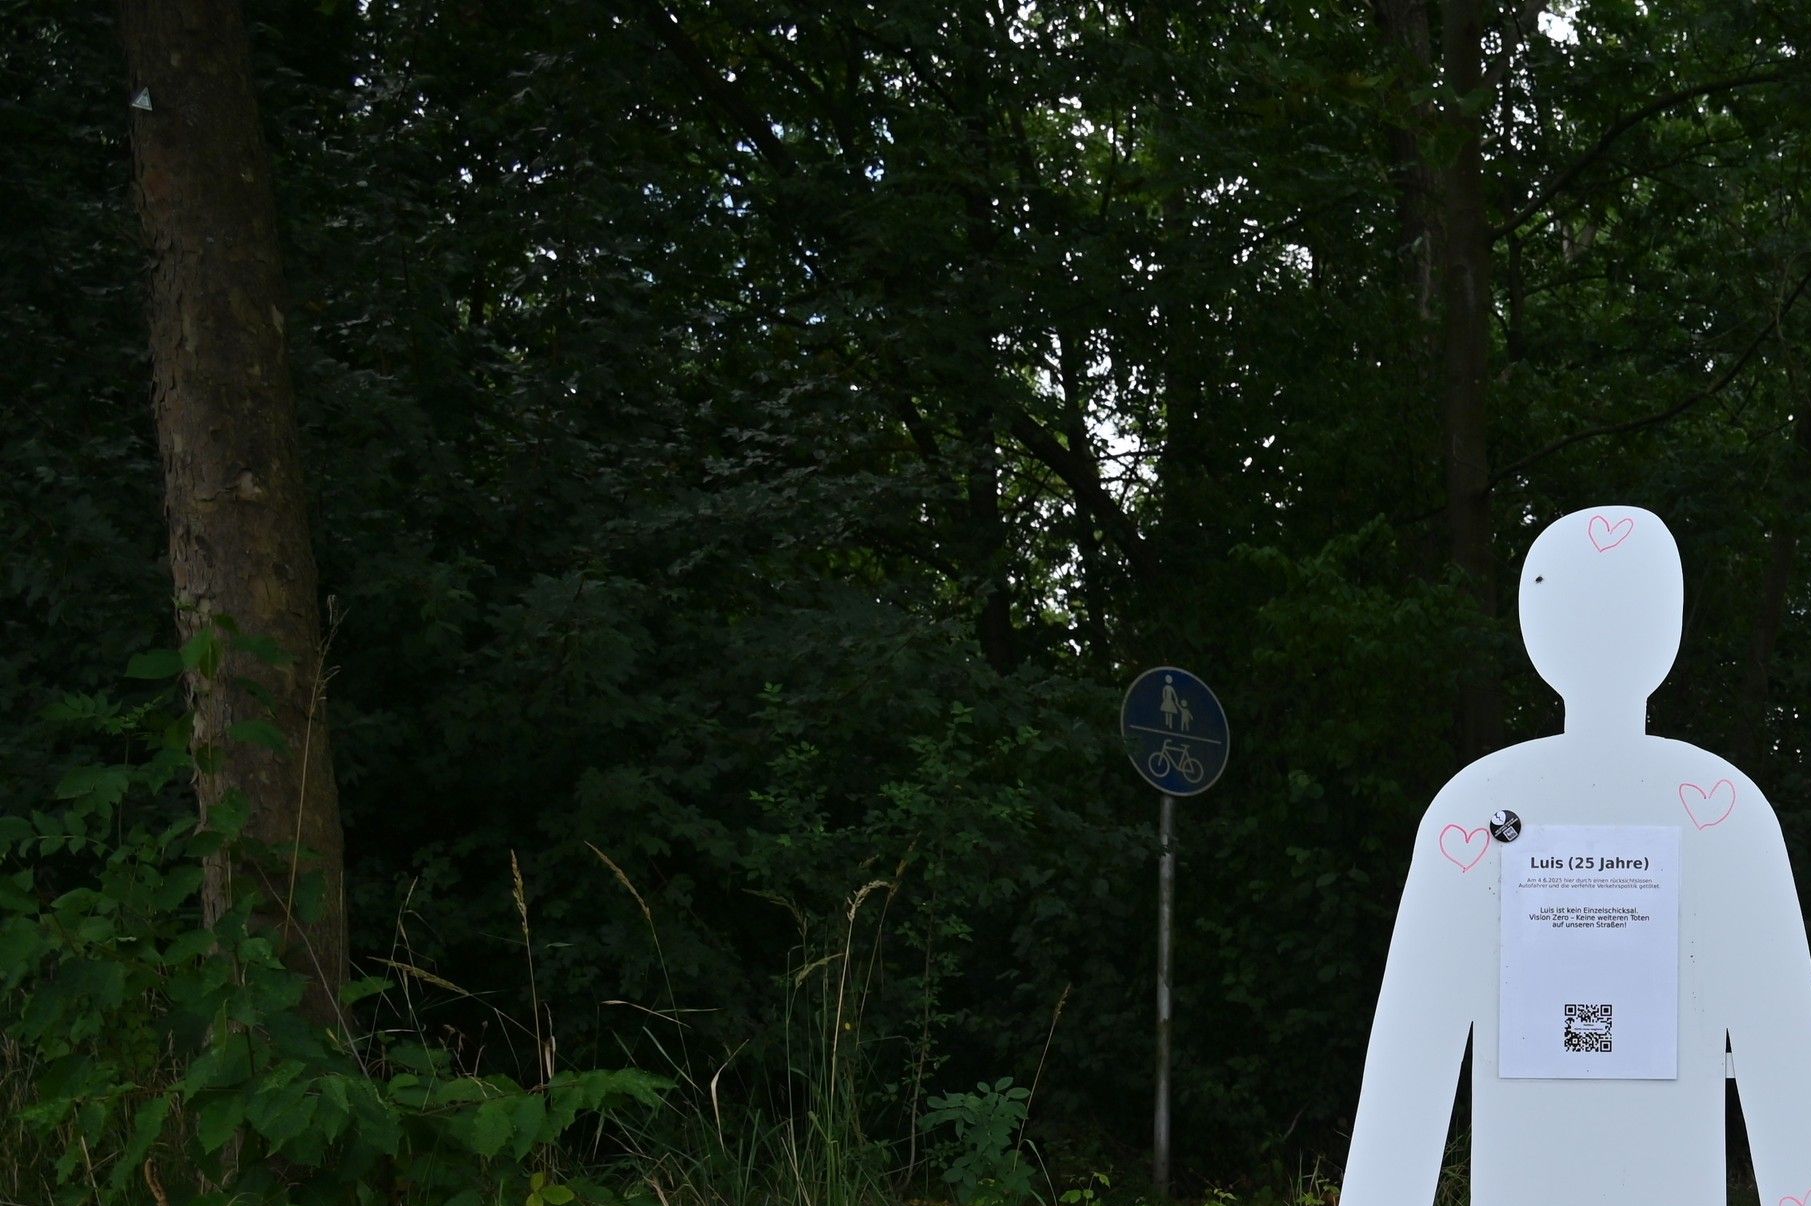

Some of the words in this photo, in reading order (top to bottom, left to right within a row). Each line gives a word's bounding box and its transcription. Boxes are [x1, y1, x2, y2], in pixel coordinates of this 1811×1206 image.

[1530, 856, 1564, 869] Luis
[1568, 856, 1595, 871] (25
[1598, 856, 1650, 872] Jahre)
